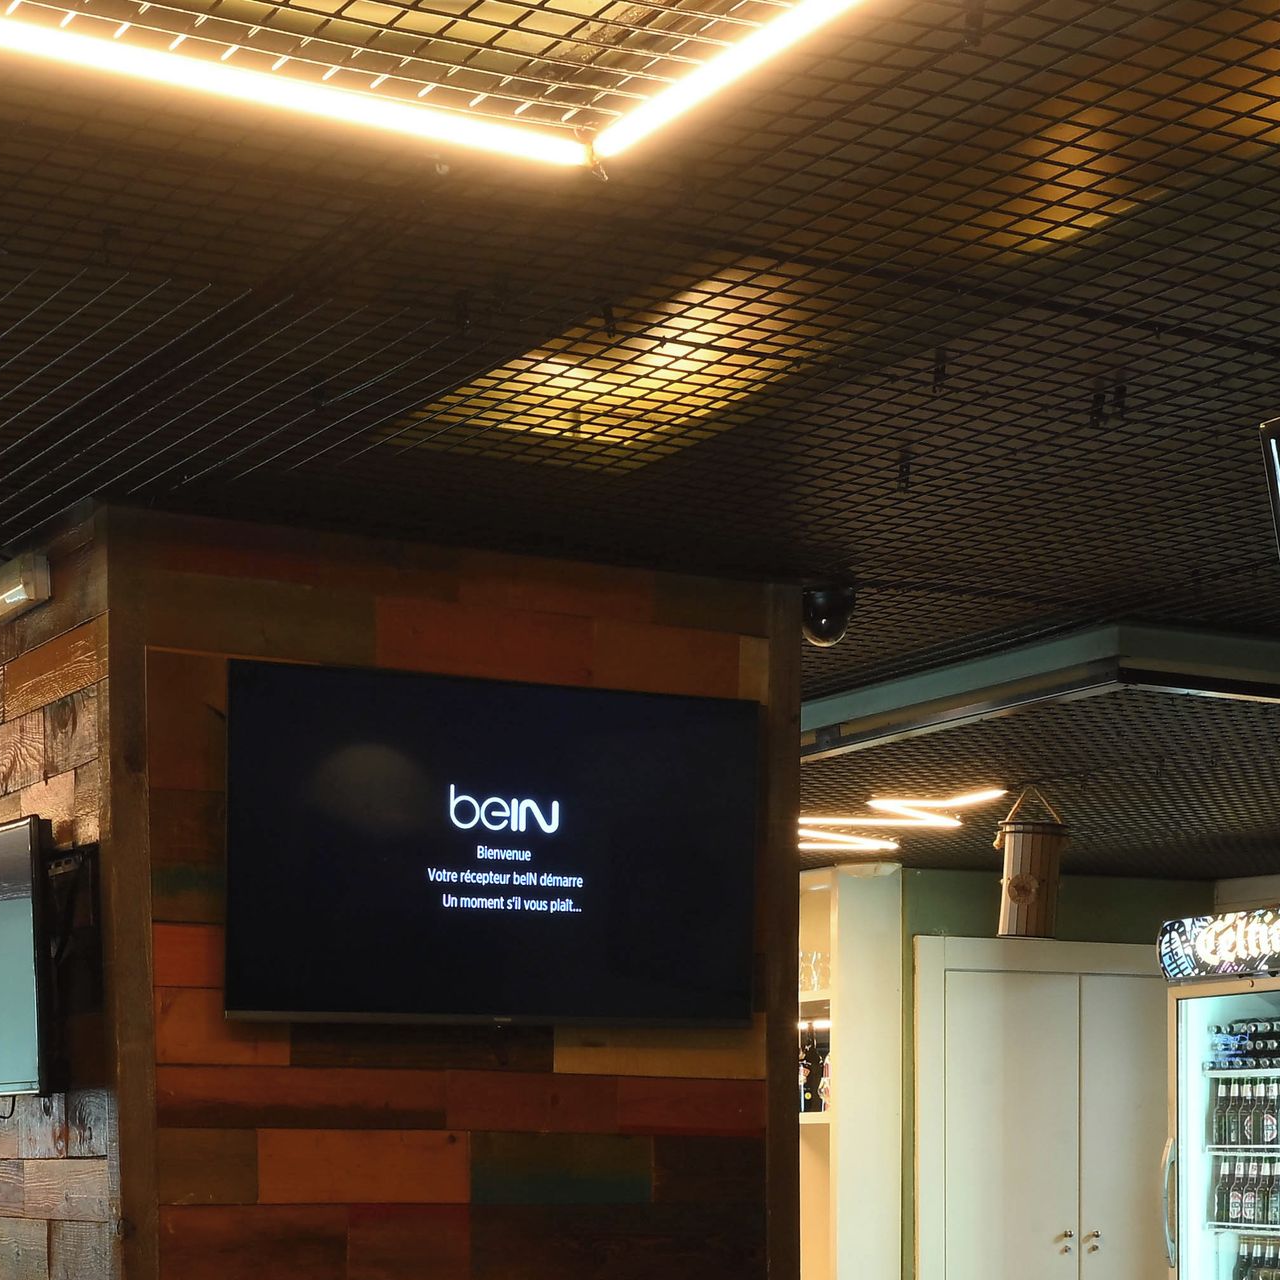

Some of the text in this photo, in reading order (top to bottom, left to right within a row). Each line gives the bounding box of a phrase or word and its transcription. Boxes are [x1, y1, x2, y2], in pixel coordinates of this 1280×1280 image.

[449, 783, 560, 834] beIN
[476, 845, 532, 862] Bienvenue
[427, 867, 583, 888] Votre récepteur beIN démarre
[442, 893, 458, 908] Un
[460, 896, 505, 911] moment
[506, 896, 521, 910] s'il
[524, 899, 548, 912] vous
